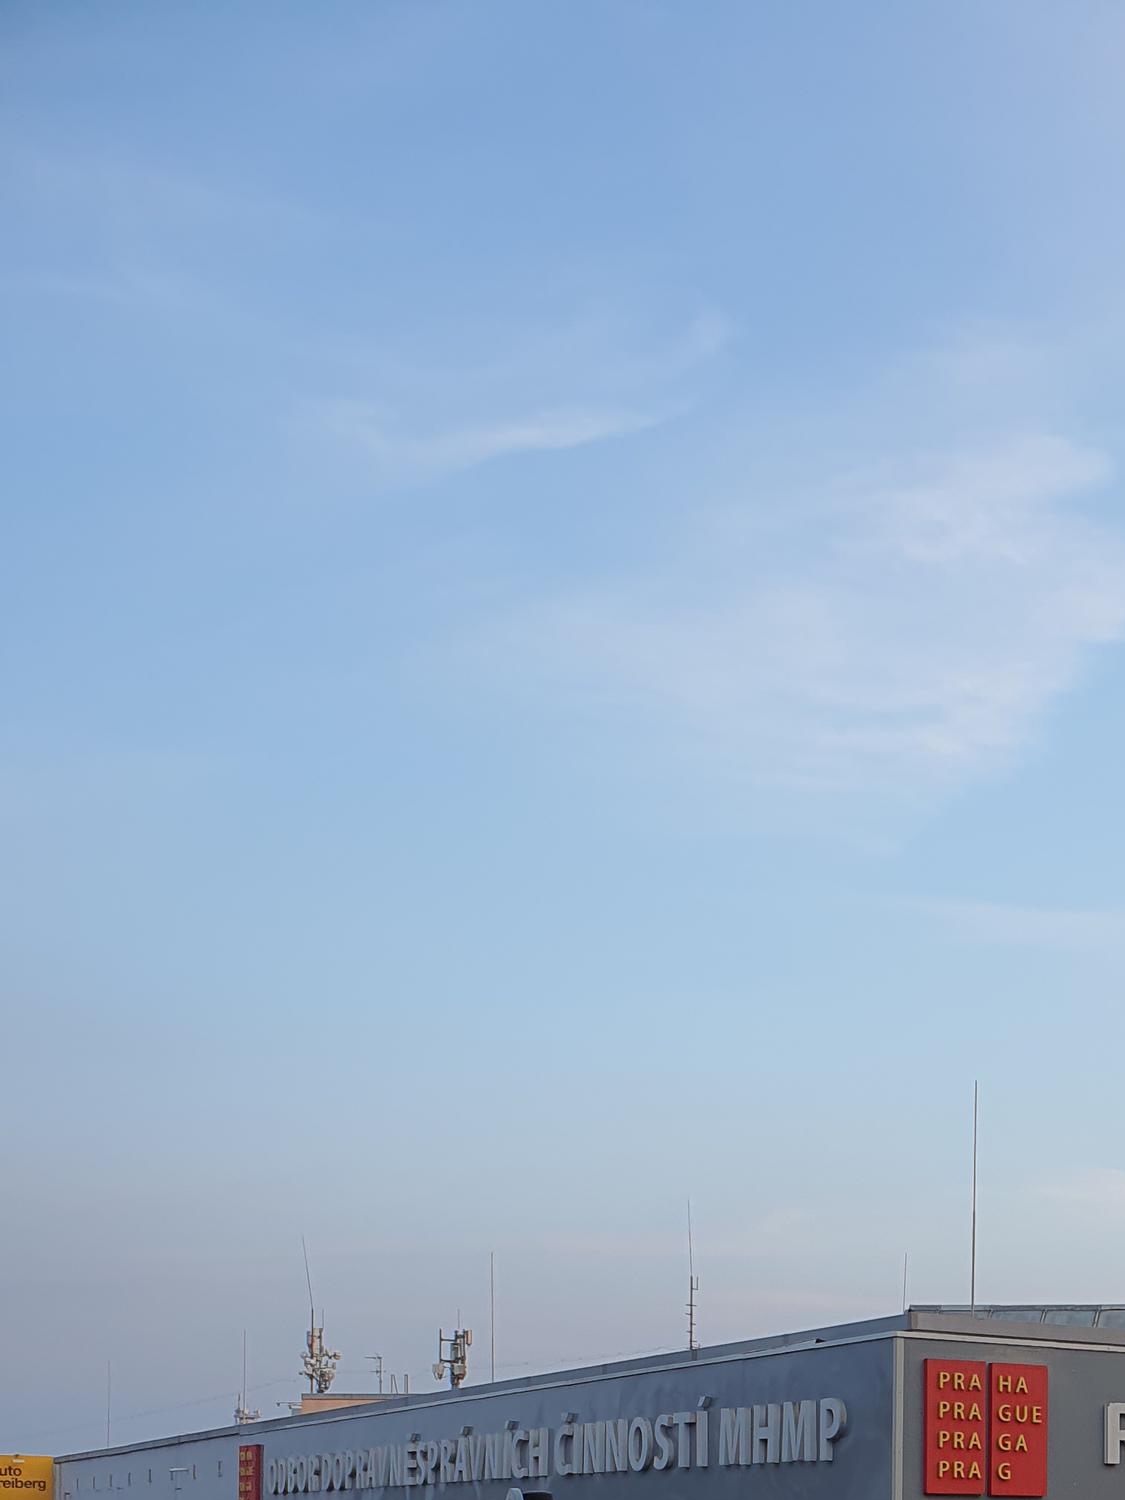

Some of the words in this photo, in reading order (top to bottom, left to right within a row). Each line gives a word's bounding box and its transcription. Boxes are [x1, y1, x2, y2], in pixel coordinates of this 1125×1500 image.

[939, 1371, 982, 1391] PRA
[998, 1375, 1029, 1394] HA
[938, 1401, 982, 1421] PRA
[998, 1404, 1043, 1423] GUE
[554, 1395, 713, 1477] ČINNOSTÍ
[719, 1397, 848, 1467] MHMP
[938, 1430, 982, 1450] PRA
[998, 1433, 1029, 1452] GA
[938, 1460, 982, 1479] PRA
[998, 1462, 1012, 1480] G
